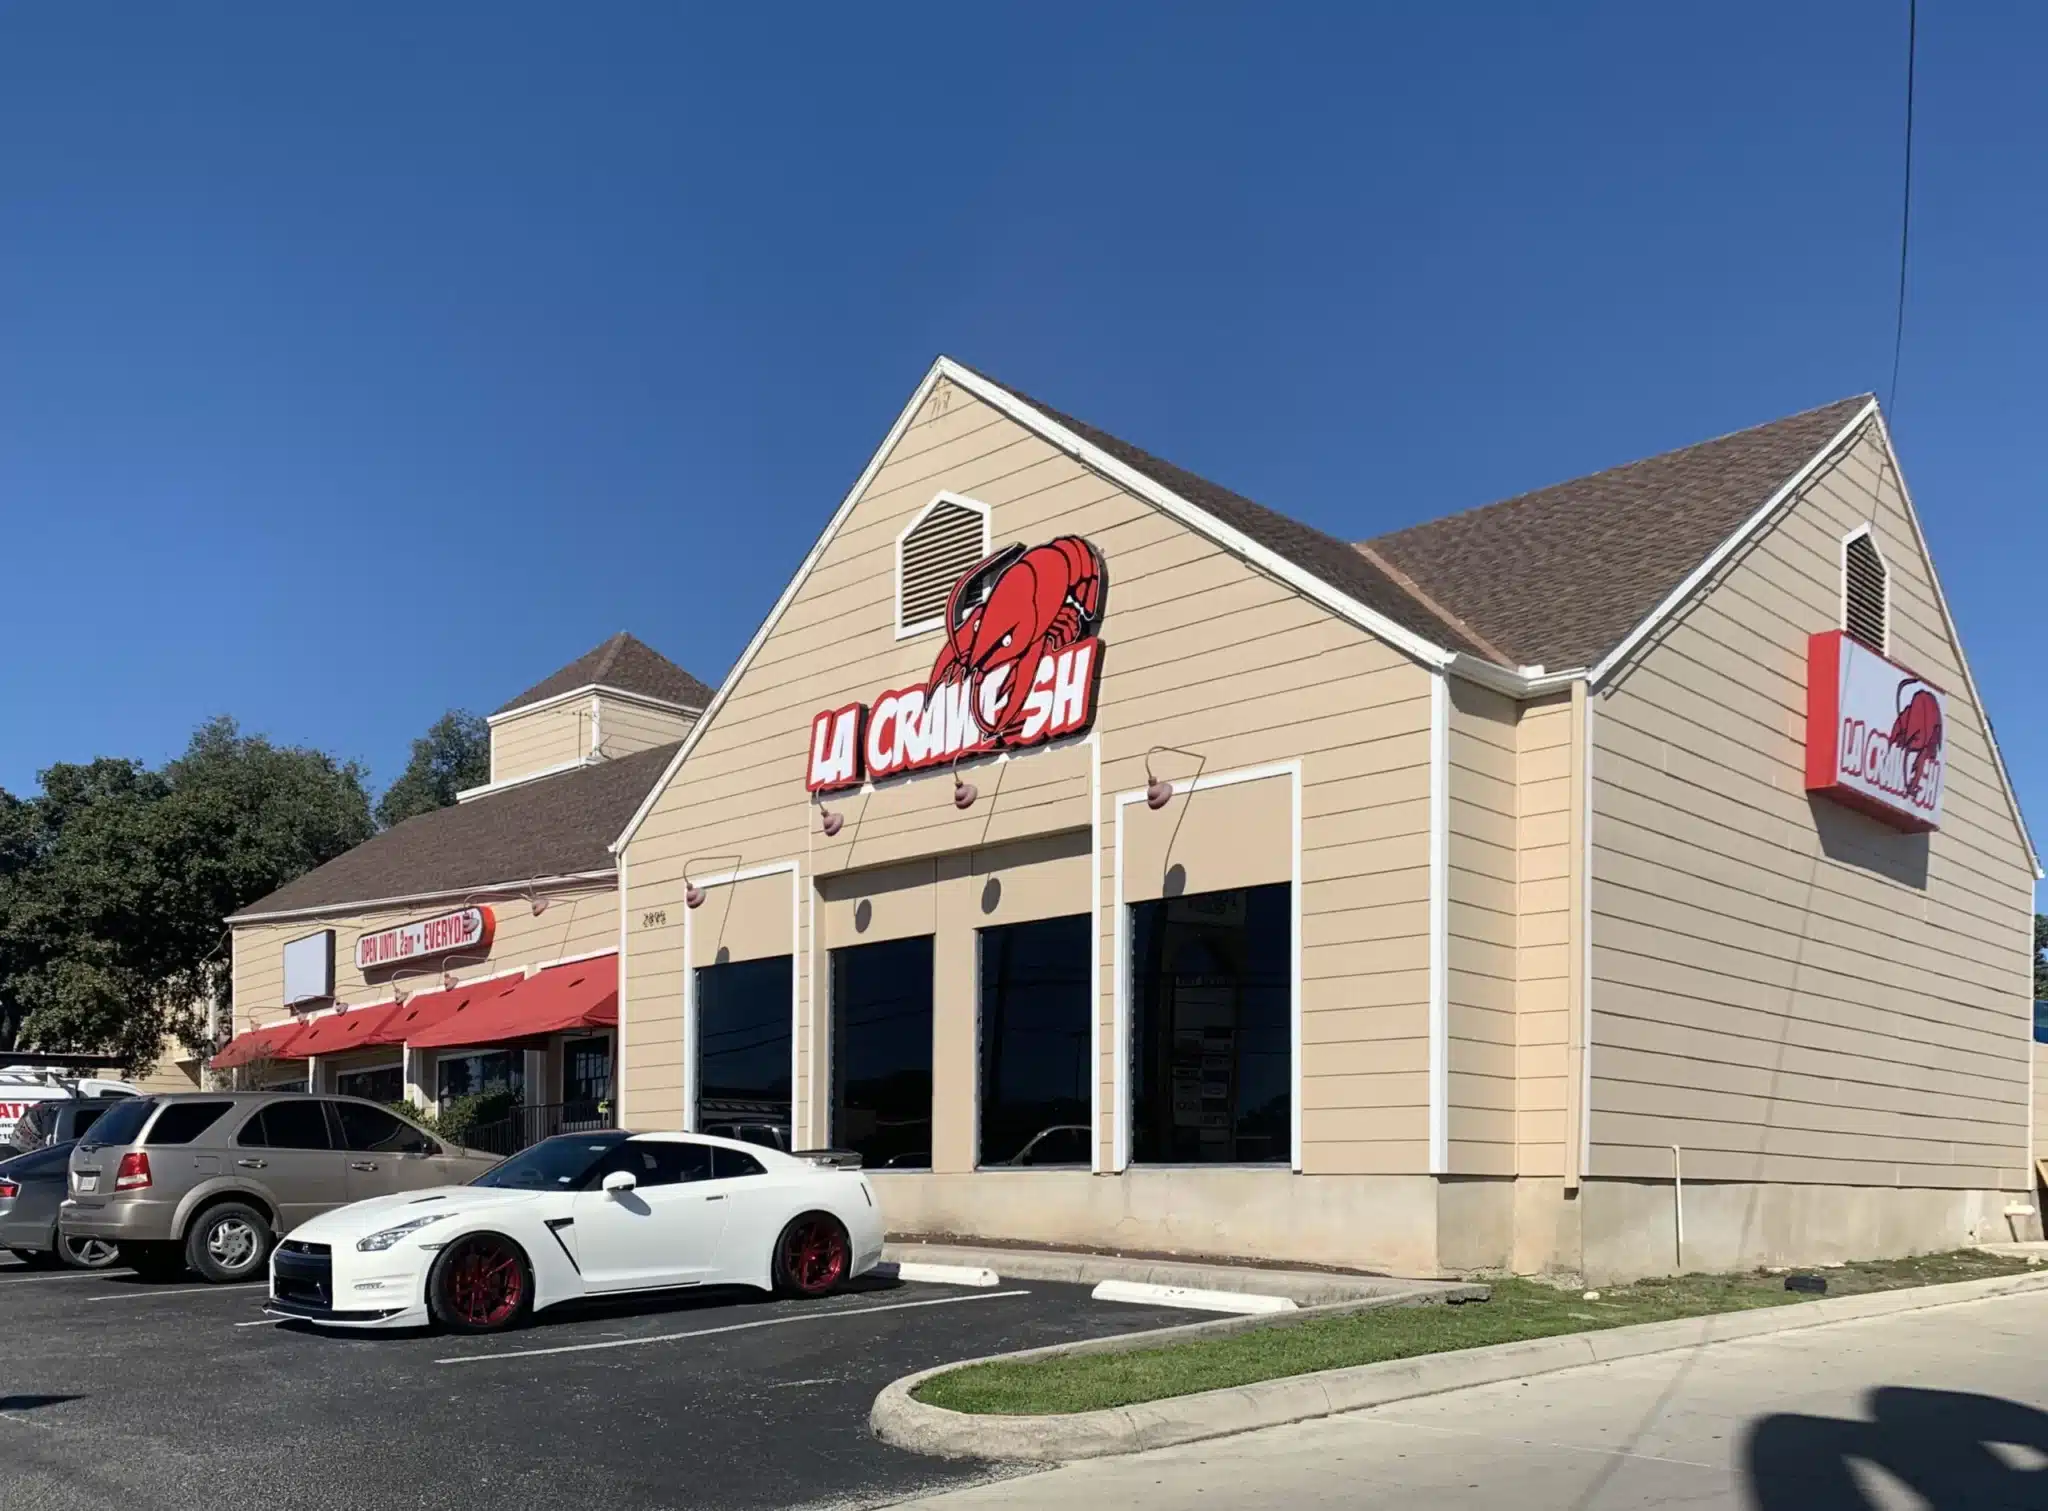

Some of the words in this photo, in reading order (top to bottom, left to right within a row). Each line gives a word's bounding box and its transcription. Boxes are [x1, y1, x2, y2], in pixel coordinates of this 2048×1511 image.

[810, 710, 857, 786] LA
[867, 645, 1092, 772] CRAWFSH
[1841, 717, 1864, 777] LA
[361, 937, 377, 965] OPEN
[379, 930, 398, 961] UNTIL
